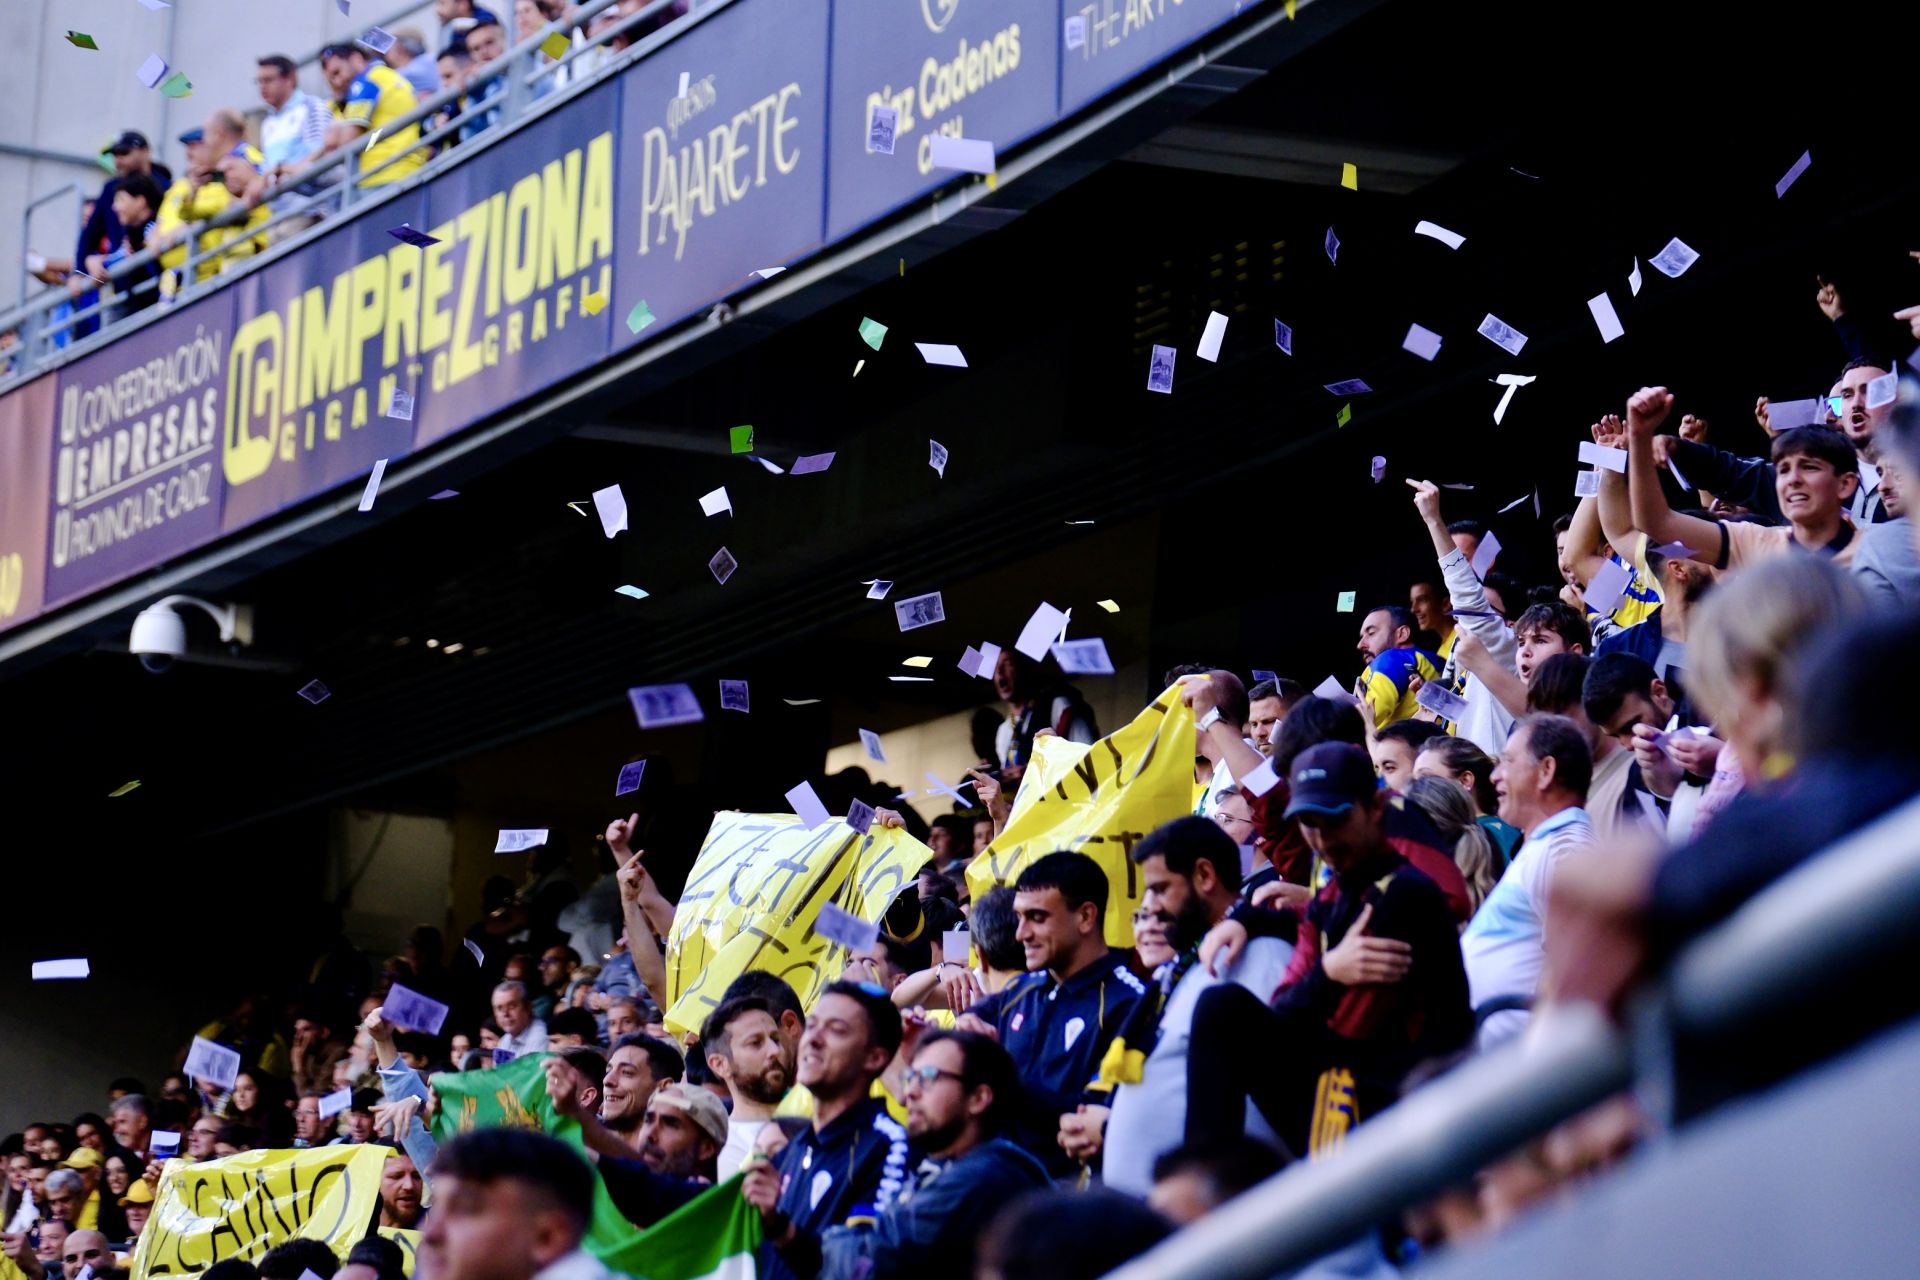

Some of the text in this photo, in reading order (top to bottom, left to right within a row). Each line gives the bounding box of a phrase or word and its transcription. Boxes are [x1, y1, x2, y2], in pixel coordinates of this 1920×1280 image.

[919, 23, 1021, 119] Cadenas
[281, 131, 613, 416] IMPREZIONA
[75, 387, 217, 499] EMPRESAS
